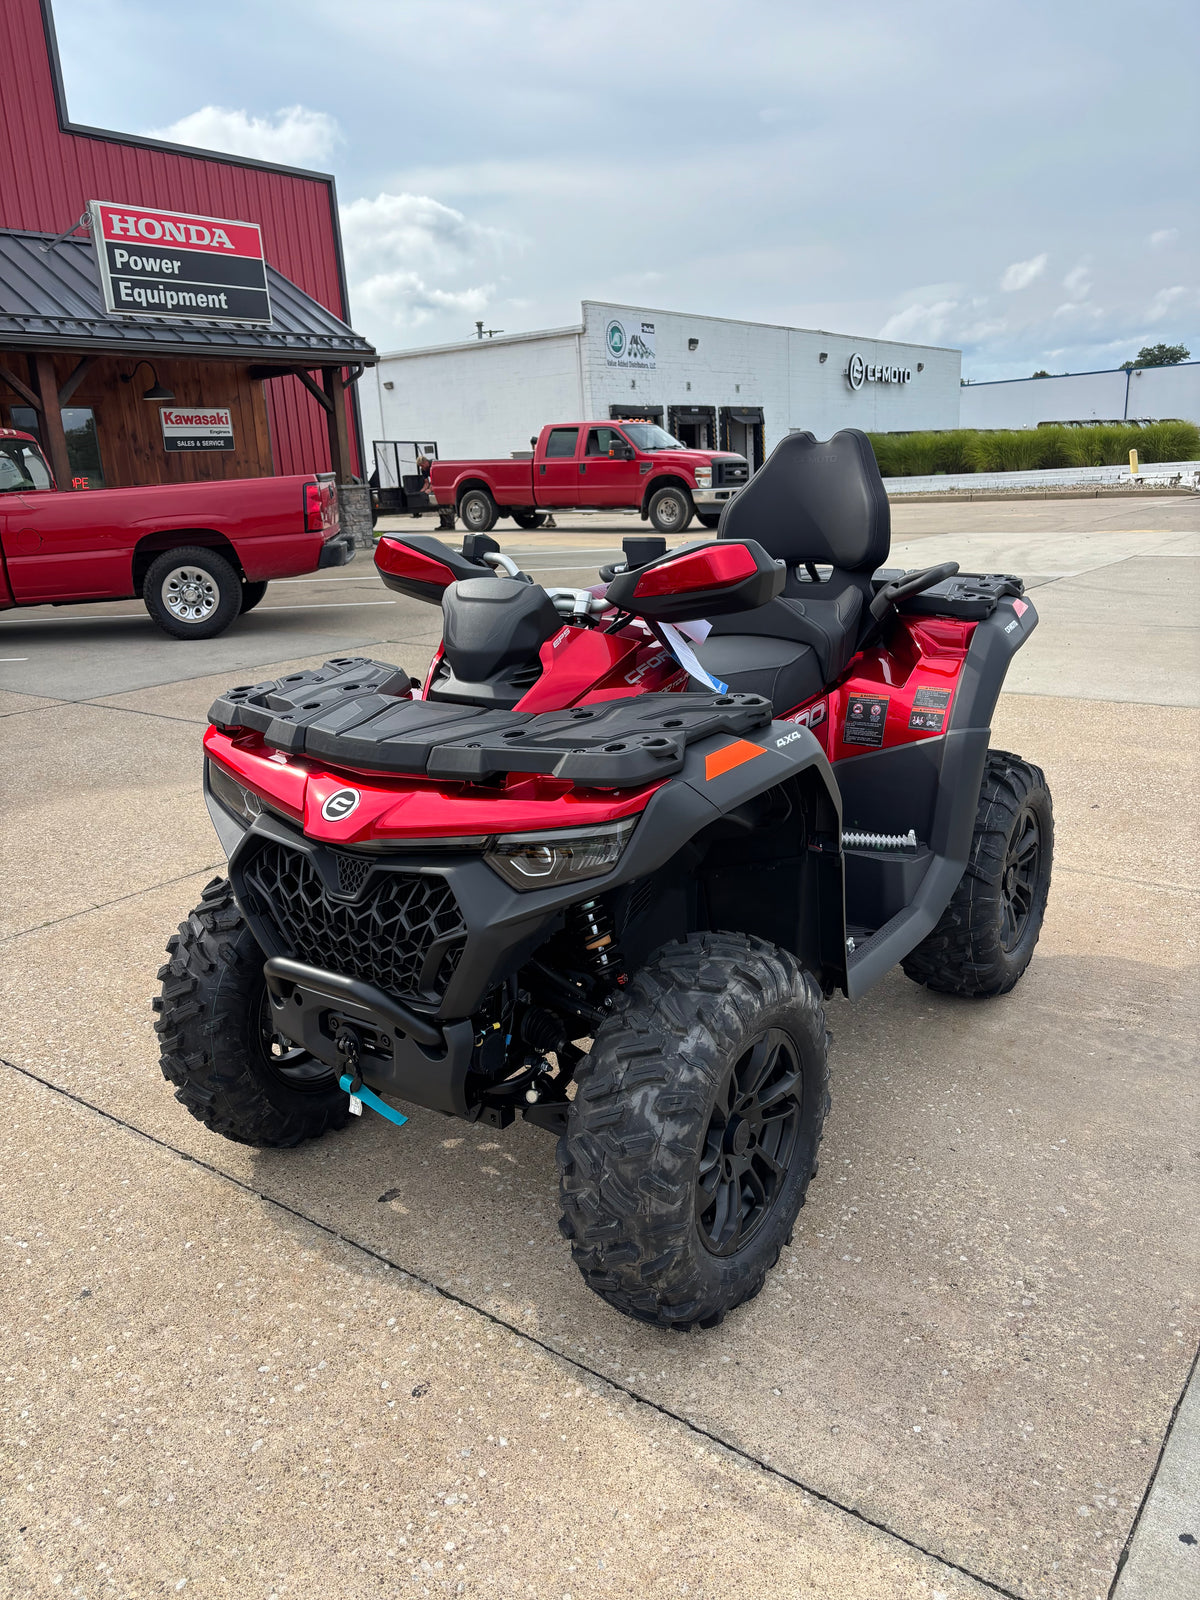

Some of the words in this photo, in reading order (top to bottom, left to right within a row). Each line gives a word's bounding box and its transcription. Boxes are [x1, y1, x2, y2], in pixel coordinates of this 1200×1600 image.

[108, 213, 235, 249] HONDA
[114, 248, 181, 274] Power
[119, 281, 228, 309] Equipment
[866, 364, 912, 384] CFMOTO
[163, 411, 229, 425] Kawasaki
[552, 627, 571, 649] EPS
[776, 731, 802, 748] 4X4
